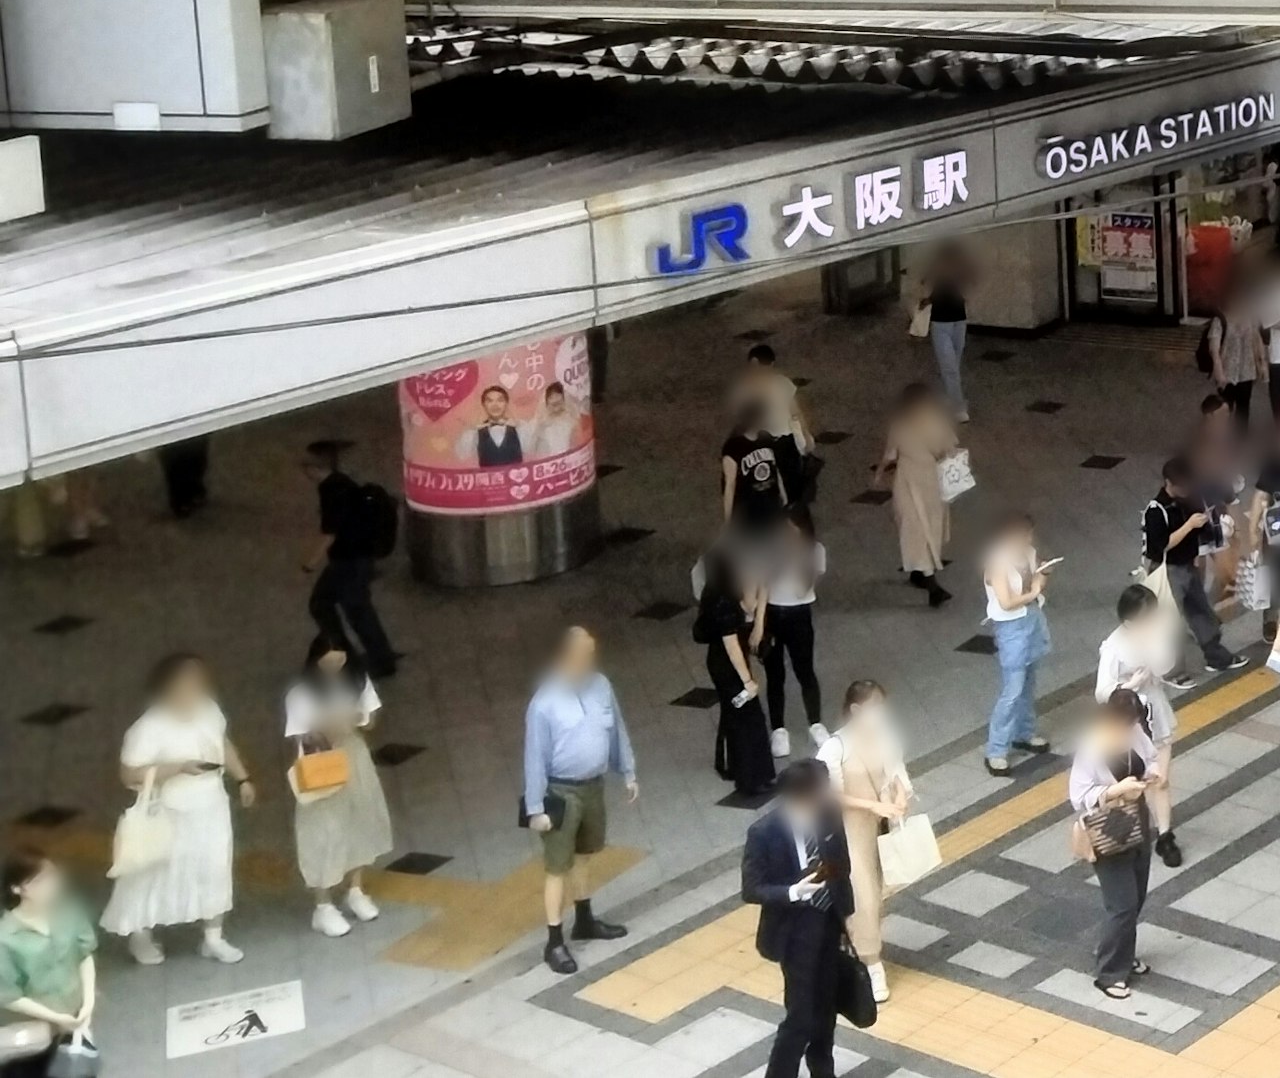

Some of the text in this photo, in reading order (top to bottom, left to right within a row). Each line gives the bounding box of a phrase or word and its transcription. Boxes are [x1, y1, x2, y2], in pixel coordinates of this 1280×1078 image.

[1160, 93, 1276, 149] STATION
[657, 150, 970, 273] JR 大阪駅
[1113, 216, 1153, 228] スタッフ
[1102, 230, 1154, 258] 募集
